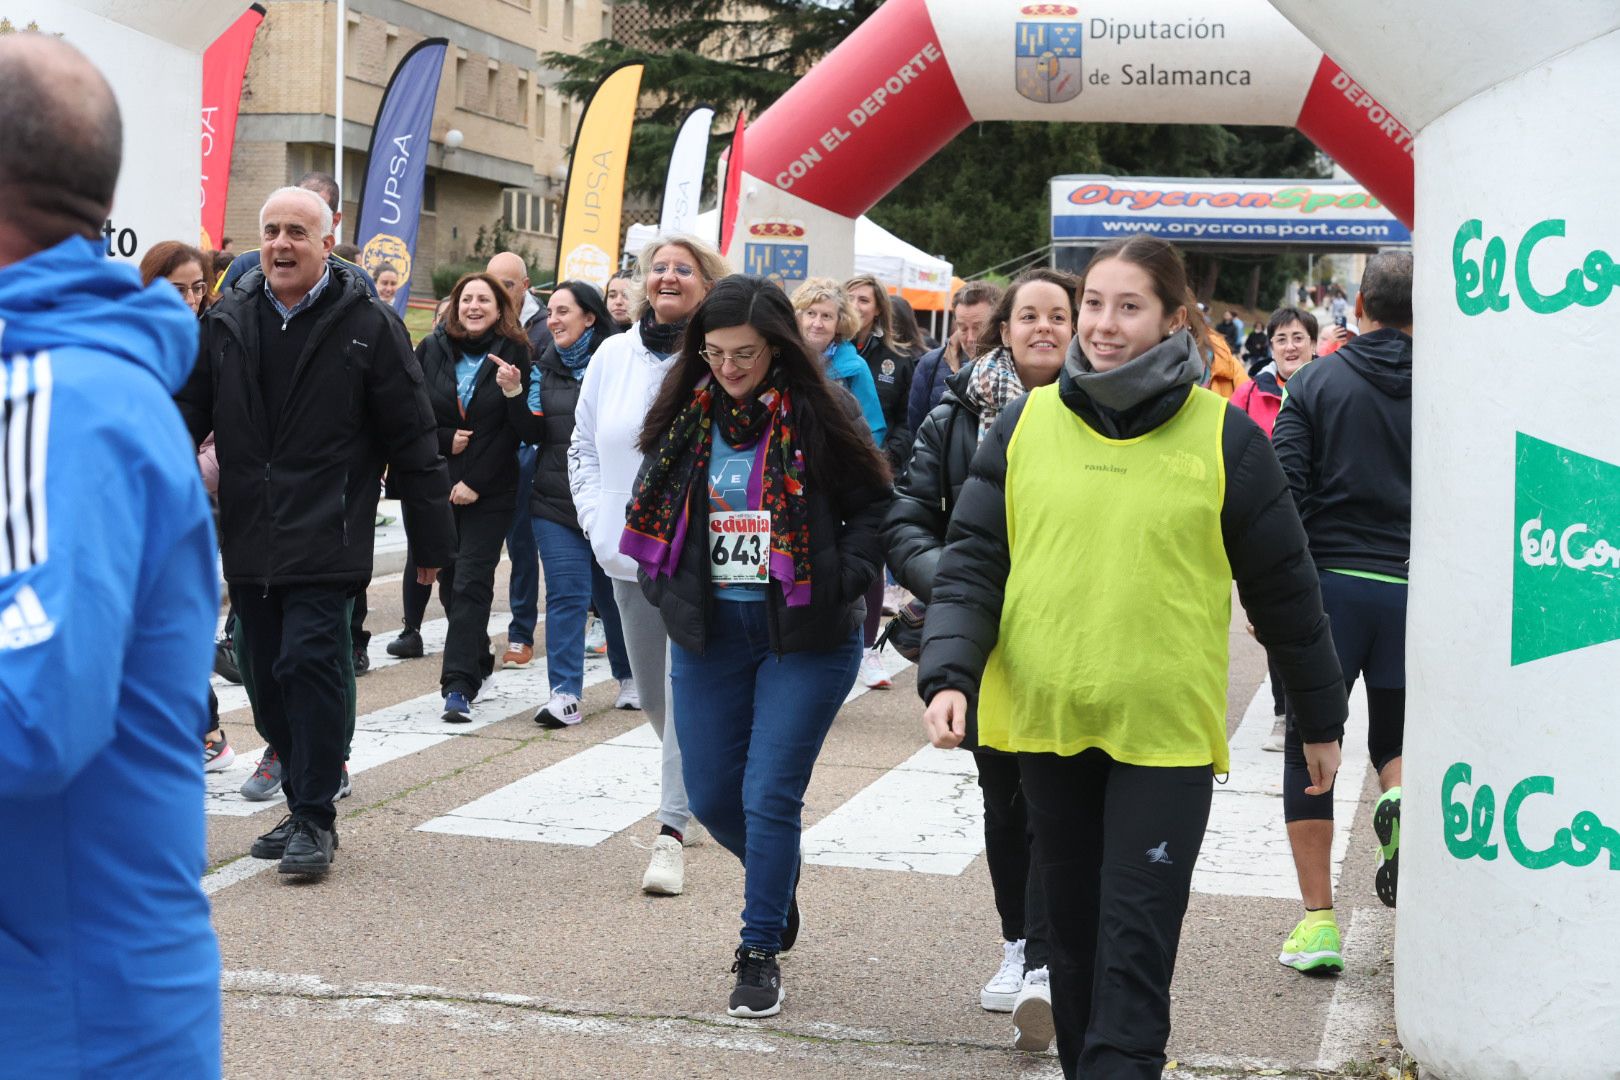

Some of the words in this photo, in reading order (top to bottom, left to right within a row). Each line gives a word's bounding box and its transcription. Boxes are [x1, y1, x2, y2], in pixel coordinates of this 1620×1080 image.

[1090, 17, 1225, 45] Diputación
[1088, 69, 1110, 85] de
[1121, 63, 1251, 86] Salamanca
[776, 147, 822, 190] CON
[819, 127, 851, 152] EL
[848, 42, 941, 128] DEPORTE
[380, 133, 413, 225] UPSA
[583, 150, 613, 234] UPSA
[1103, 221, 1389, 236] www.orycronsport.com
[1084, 464, 1128, 475] ranking
[711, 534, 761, 566] 643
